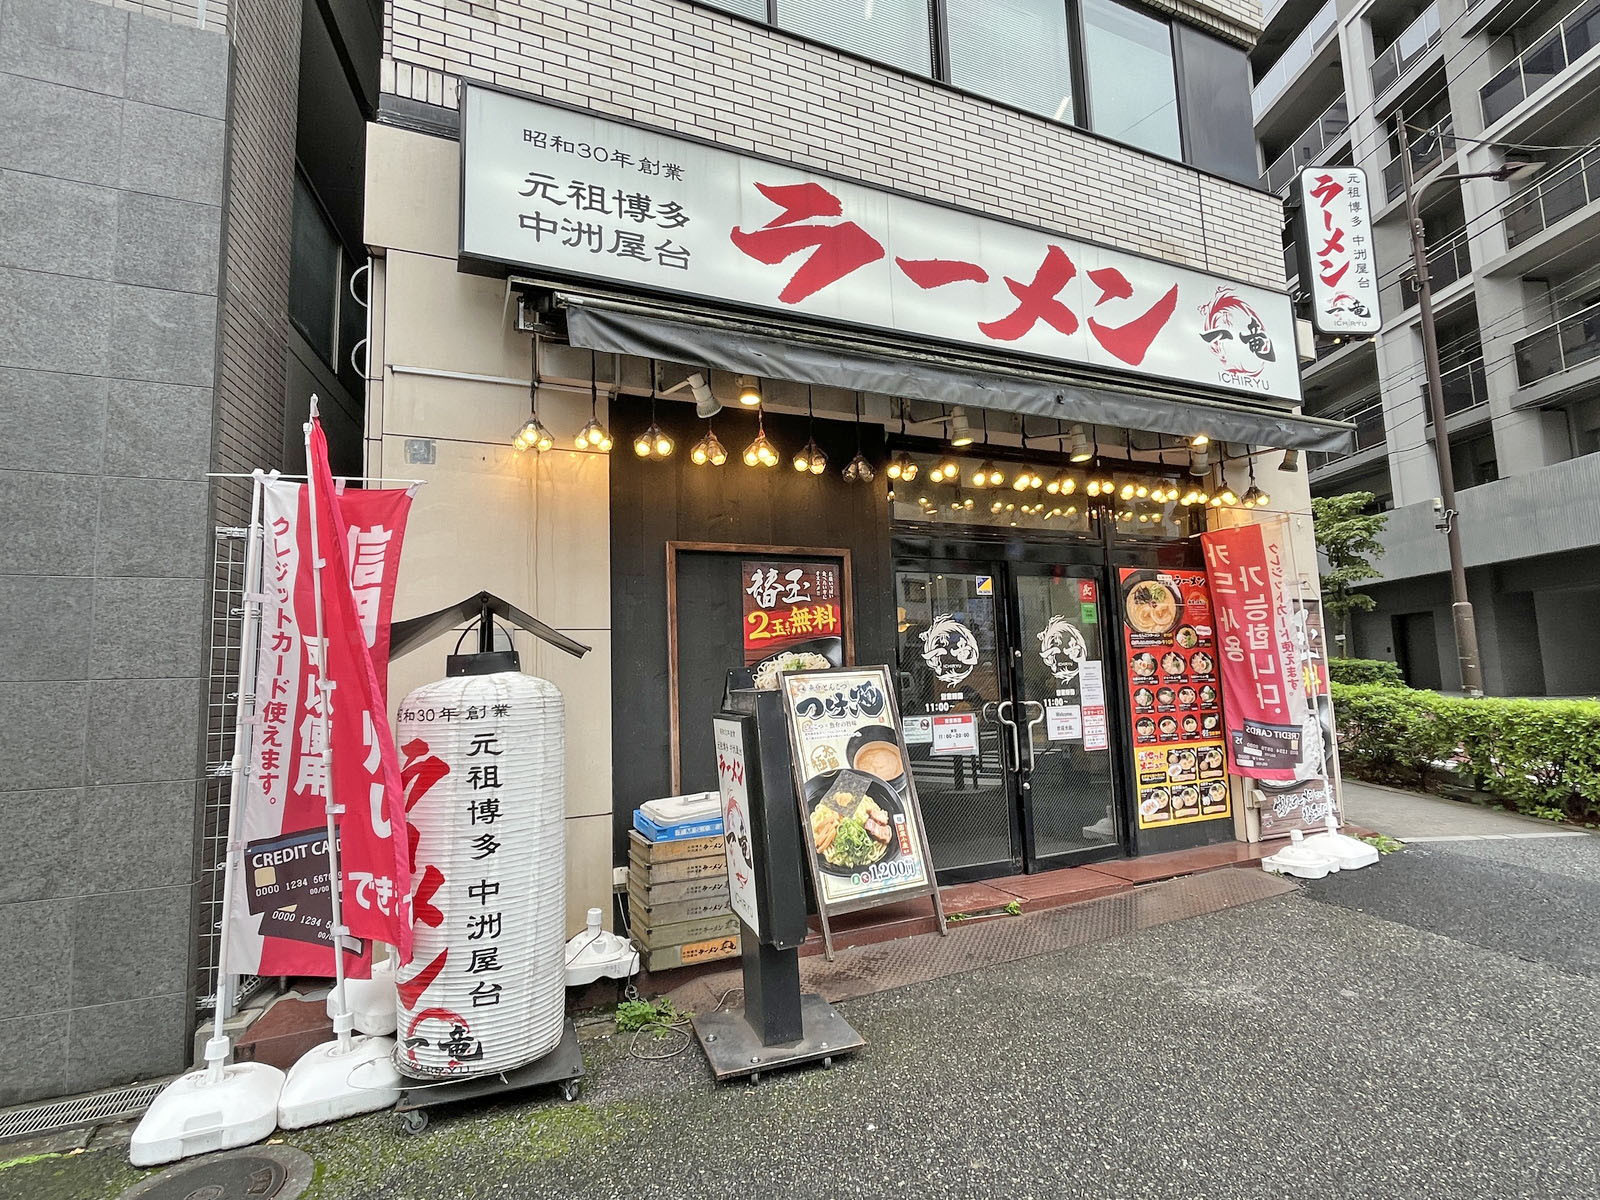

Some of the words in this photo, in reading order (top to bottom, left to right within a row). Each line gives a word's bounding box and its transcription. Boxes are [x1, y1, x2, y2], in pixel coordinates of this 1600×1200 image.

[523, 128, 685, 181] 昭和30年創業
[518, 172, 691, 229] 元祖博多
[518, 211, 691, 271] 中洲屋台
[1310, 174, 1350, 288] ラーメン
[730, 182, 1179, 366] ラーメン
[1199, 317, 1276, 362] 一竜
[1217, 371, 1270, 391] ICHIRYU
[746, 568, 811, 608] 替玉
[258, 516, 293, 806] クレジットカード使えます。
[252, 844, 308, 868] CREDIT
[255, 884, 280, 897] 0000
[286, 878, 308, 891] 1234
[272, 910, 296, 922] 0000
[300, 915, 322, 927] 1234
